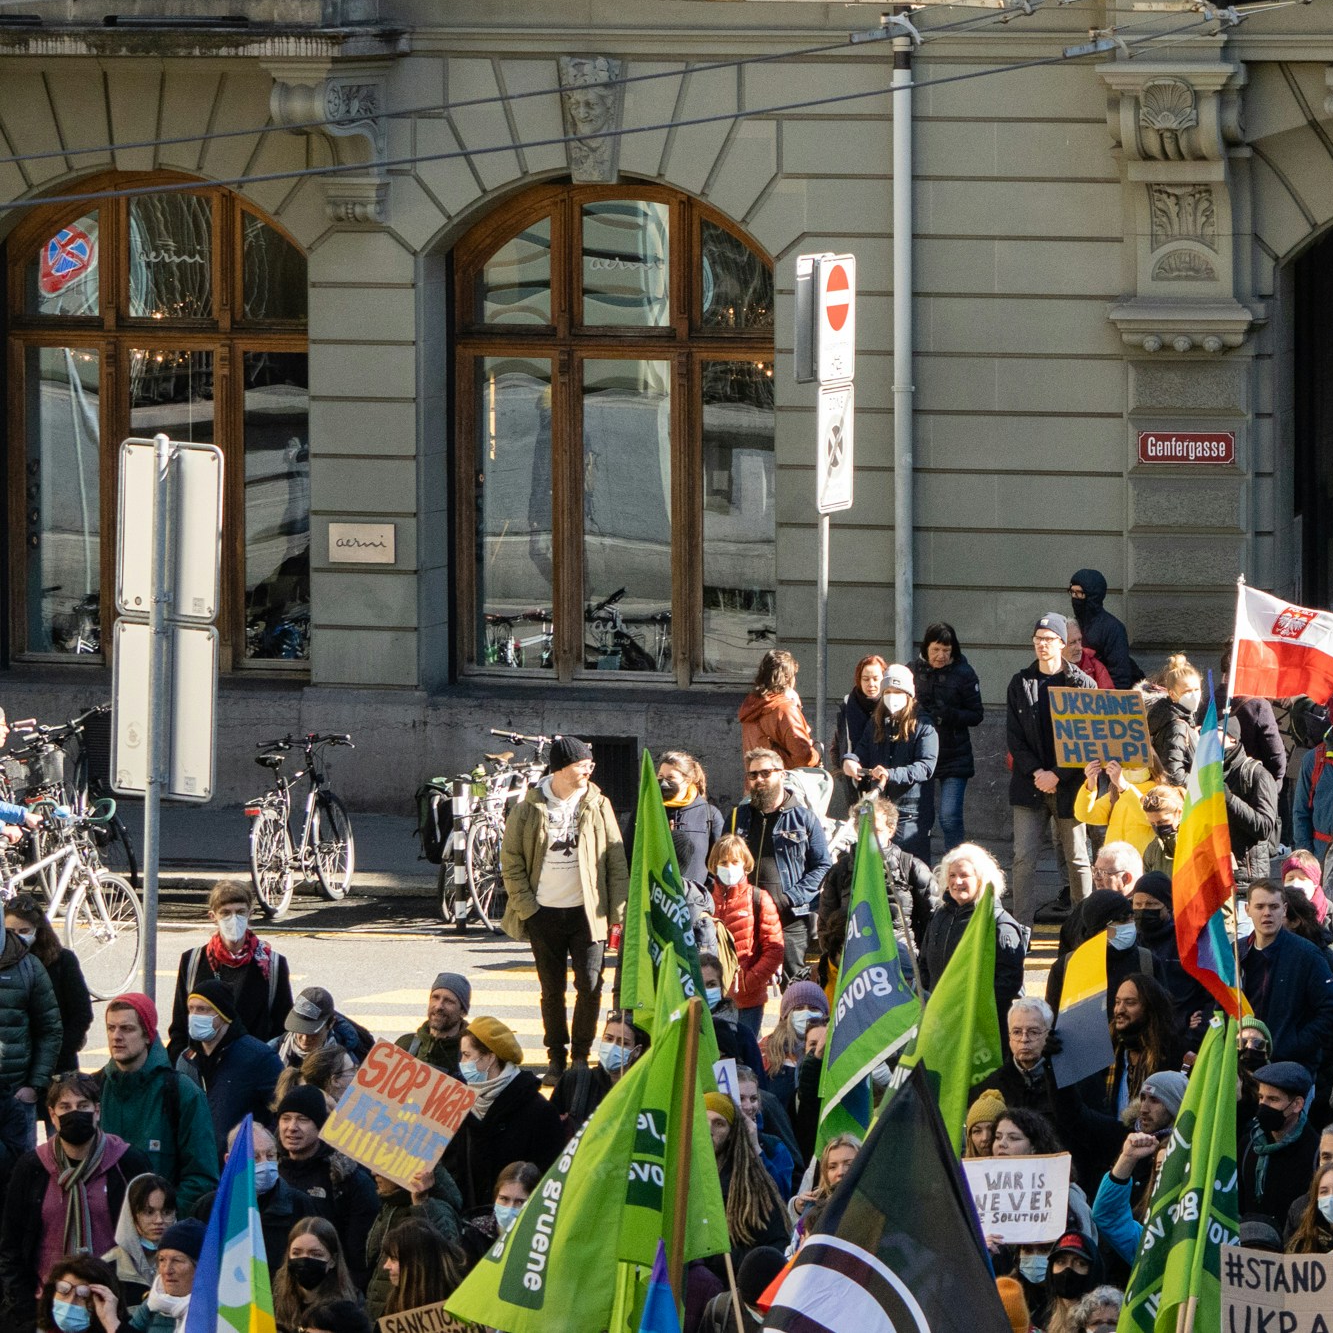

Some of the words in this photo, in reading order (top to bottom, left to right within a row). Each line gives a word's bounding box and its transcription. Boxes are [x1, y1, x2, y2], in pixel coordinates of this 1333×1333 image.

[1147, 436, 1226, 459] Genfergasse
[336, 535, 387, 548] aerni
[1049, 689, 1140, 716] UKRAINE
[1053, 719, 1145, 742] NEEDS
[1063, 741, 1149, 763] HELP!
[357, 1043, 426, 1104] STOP
[984, 1171, 1024, 1191] WAR
[1030, 1172, 1046, 1189] IS
[991, 1211, 1049, 1224] SOLUTION
[522, 1177, 562, 1295] gruene
[1225, 1252, 1327, 1293] #STAND
